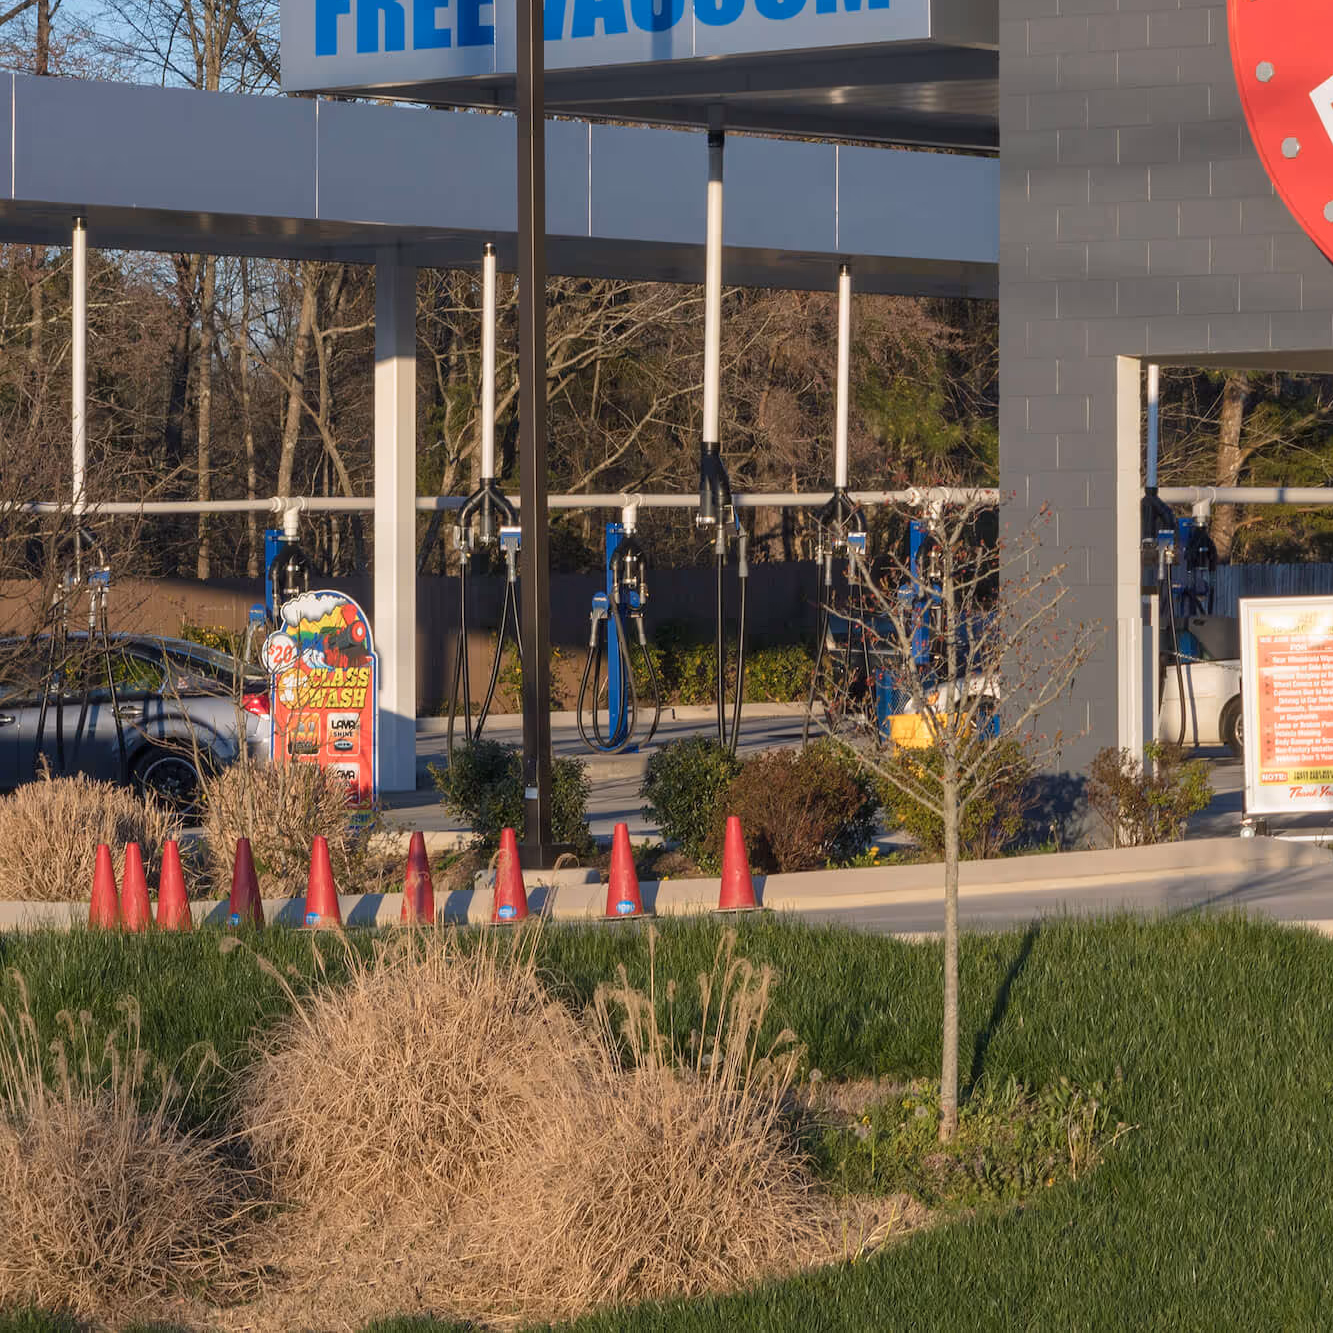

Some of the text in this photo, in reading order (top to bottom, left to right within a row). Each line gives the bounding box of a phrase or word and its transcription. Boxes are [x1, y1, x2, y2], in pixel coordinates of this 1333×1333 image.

[310, 667, 370, 687] CLASS
[309, 688, 366, 708] WASH
[331, 720, 356, 729] LAVA
[1289, 786, 1317, 798] Thank
